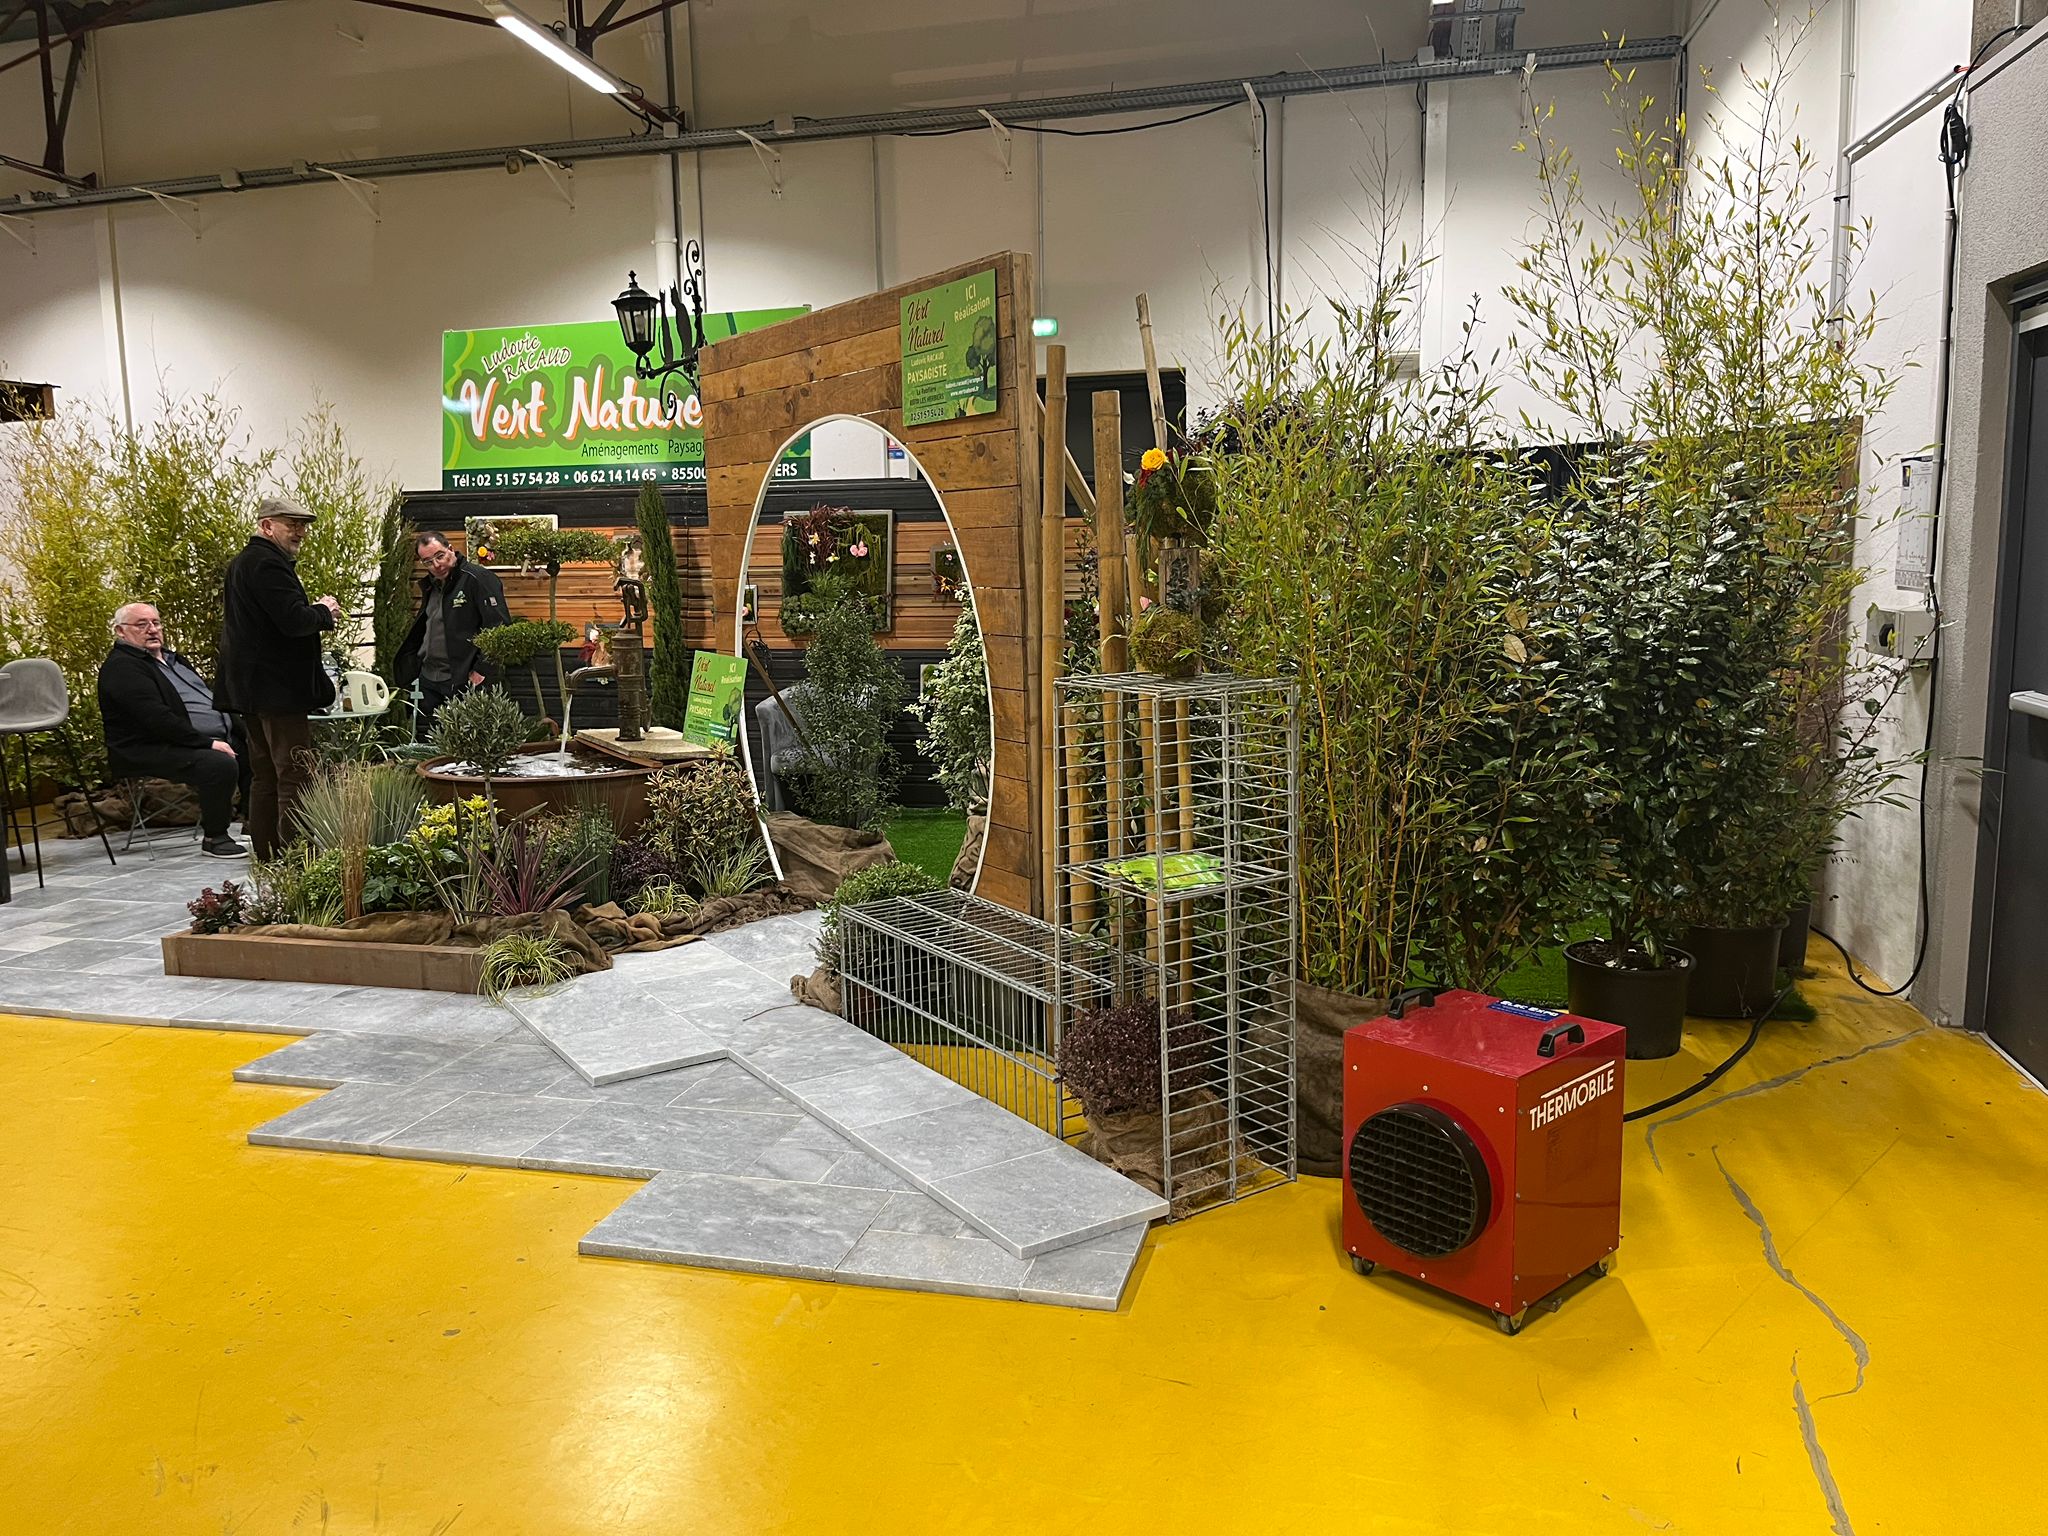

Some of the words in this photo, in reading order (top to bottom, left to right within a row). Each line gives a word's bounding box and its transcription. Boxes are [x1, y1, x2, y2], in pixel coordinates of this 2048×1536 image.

[965, 283, 976, 301] ICI
[908, 298, 931, 326] Vert
[954, 296, 991, 323] Réalisation
[908, 321, 945, 351] Naturel
[482, 332, 541, 373] Ludovic
[503, 347, 571, 383] RACAUD
[908, 364, 947, 385] PAYSAGISTE
[459, 377, 547, 441] Vert
[562, 364, 704, 440] Nature
[581, 442, 659, 460] Aménagements
[668, 439, 704, 457] Paysag
[496, 473, 509, 486] 51
[512, 472, 525, 485] 57
[529, 472, 543, 485] 54
[545, 471, 560, 484] 28
[574, 470, 588, 483] 06
[590, 470, 605, 483] 62
[609, 469, 623, 482] 14
[626, 468, 640, 481] 14
[641, 468, 657, 481] 65
[772, 463, 798, 477] ERS
[1529, 1068, 1615, 1131] THERMOBILE
